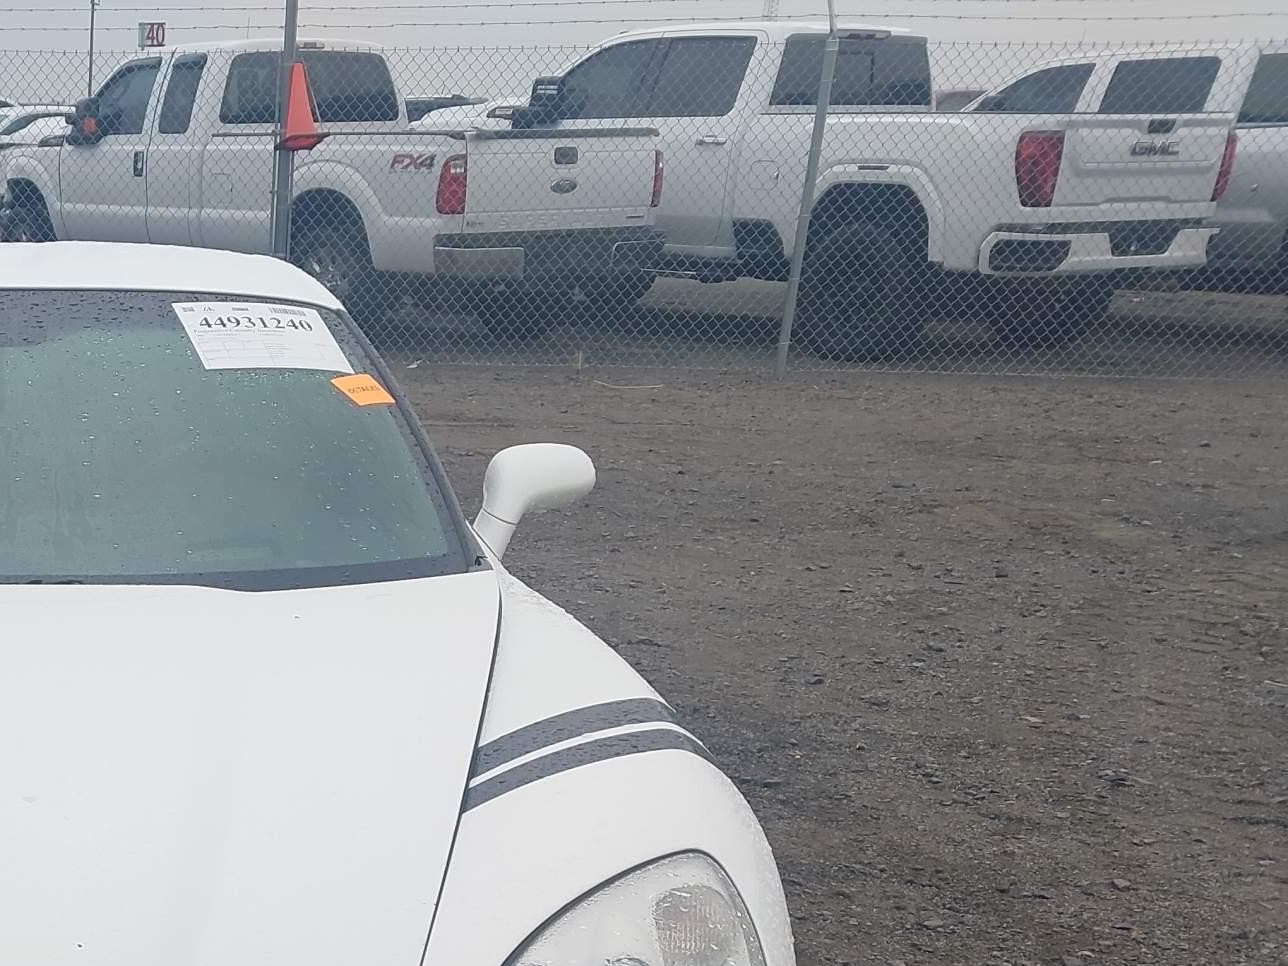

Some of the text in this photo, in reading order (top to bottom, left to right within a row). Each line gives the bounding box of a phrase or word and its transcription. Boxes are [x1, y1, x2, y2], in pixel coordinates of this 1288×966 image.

[146, 23, 165, 45] 40
[1130, 141, 1180, 156] GMC
[390, 153, 437, 169] FX4
[199, 316, 313, 332] 44931240
